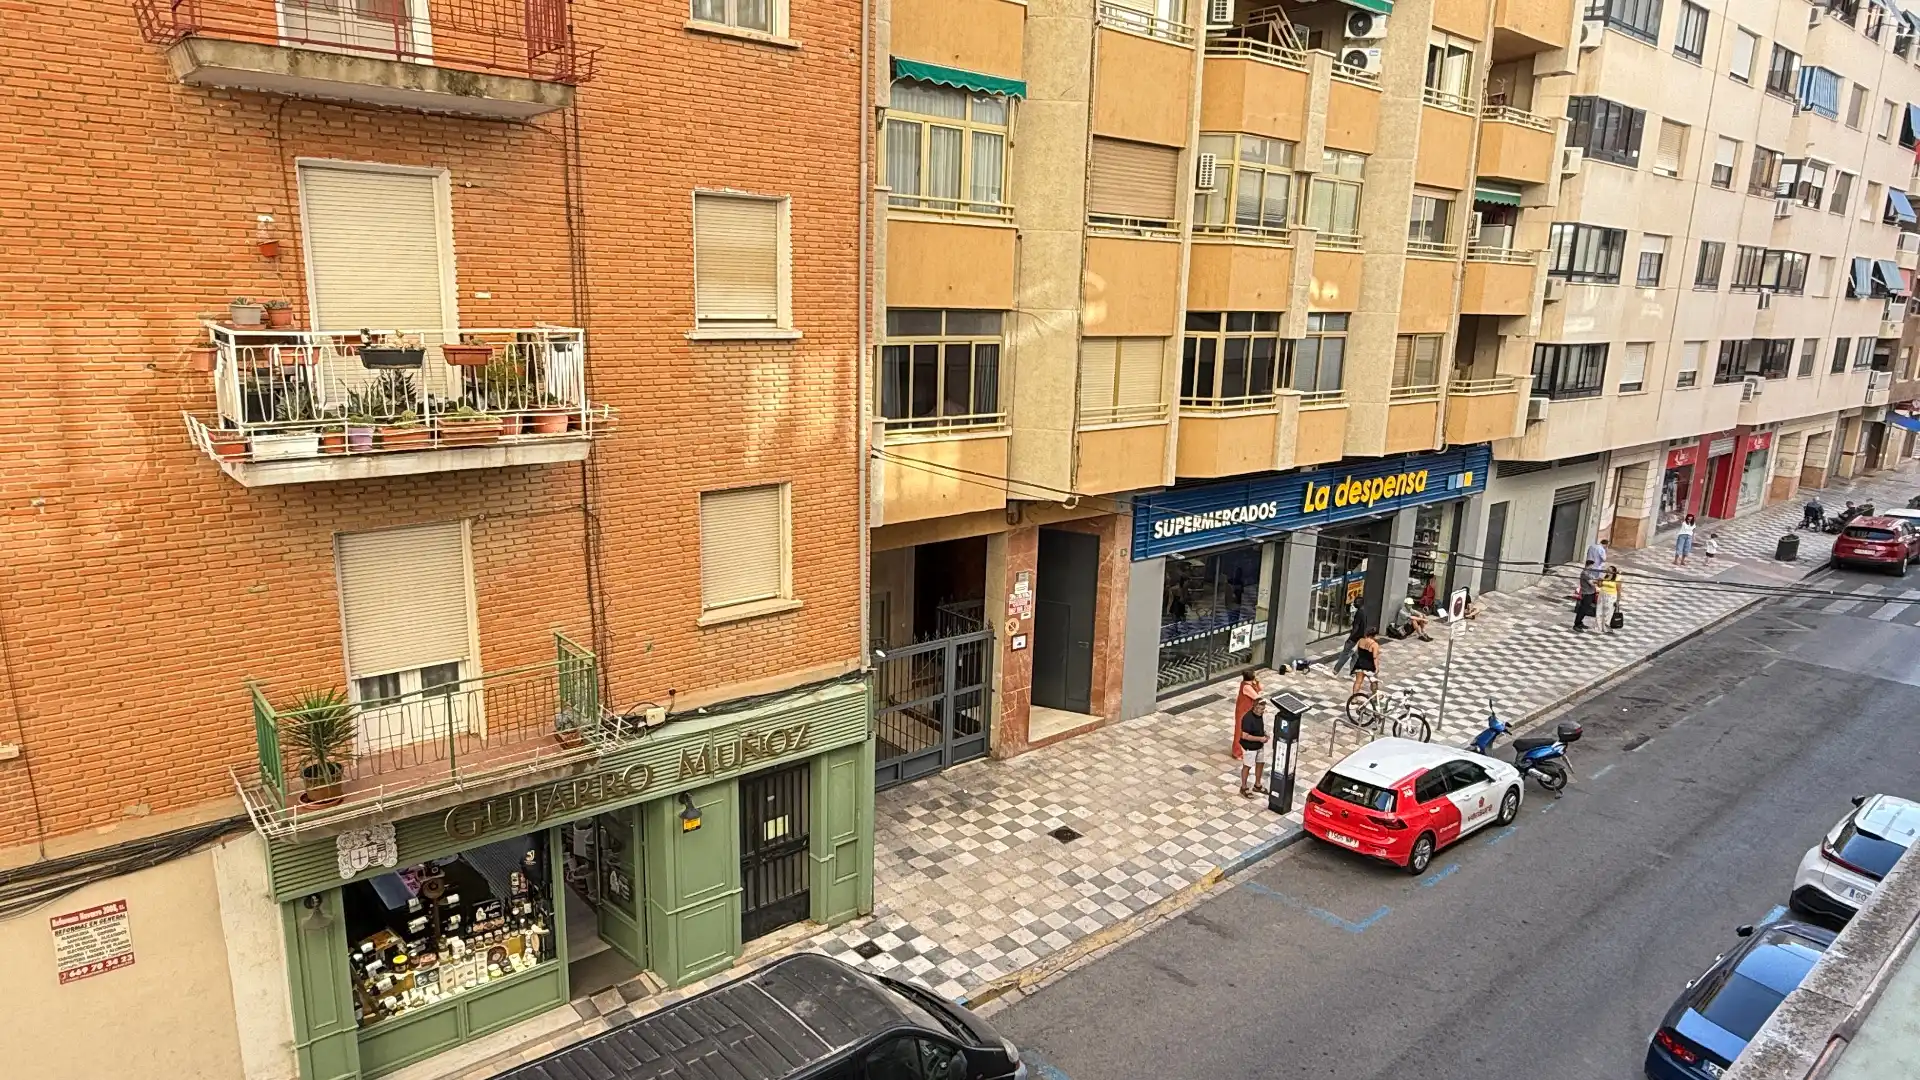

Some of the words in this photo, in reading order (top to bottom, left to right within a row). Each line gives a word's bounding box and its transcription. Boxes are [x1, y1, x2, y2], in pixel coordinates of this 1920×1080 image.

[1303, 481, 1330, 513] La
[1334, 469, 1428, 507] despensa
[1154, 501, 1277, 539] SUPERMERCADOS
[444, 763, 653, 841] GUIJARRO
[676, 724, 811, 781] MUÑOZ
[120, 953, 132, 962] 23
